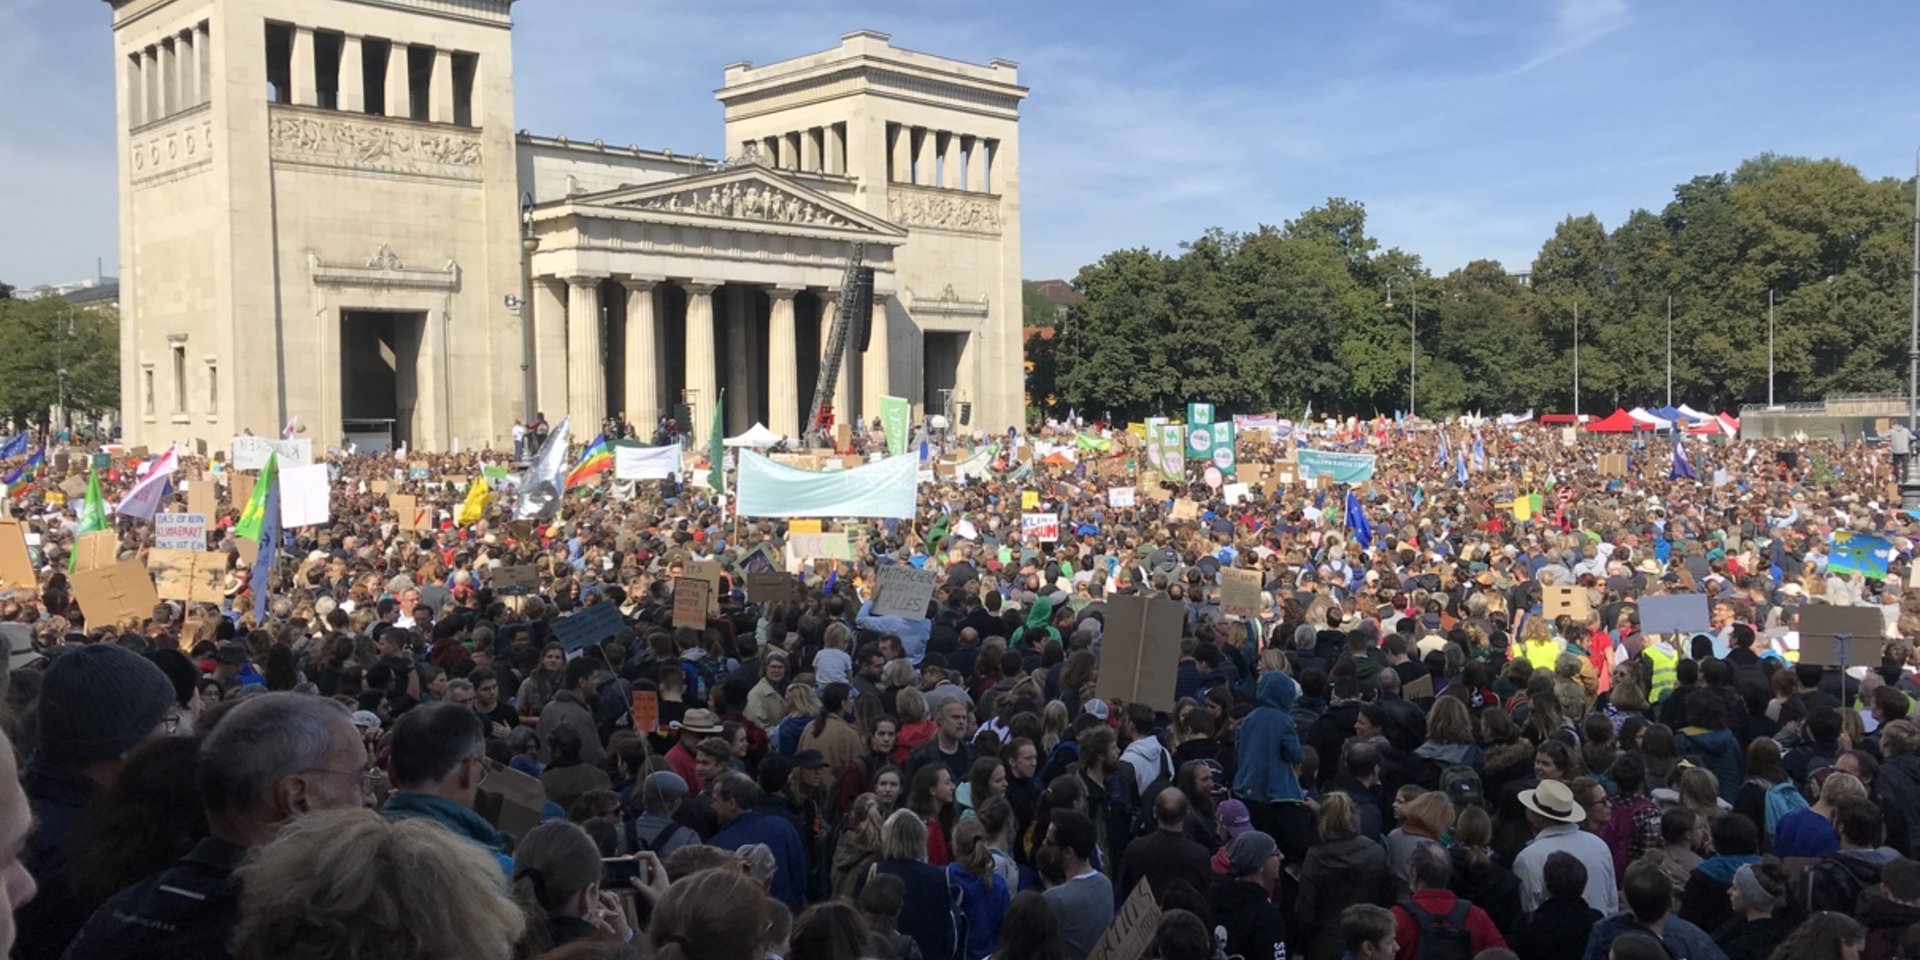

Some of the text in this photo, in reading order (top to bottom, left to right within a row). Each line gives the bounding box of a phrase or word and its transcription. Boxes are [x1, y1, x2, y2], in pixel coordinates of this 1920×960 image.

[157, 515, 173, 524] DAS
[176, 515, 187, 523] IST
[157, 541, 204, 550] DAS IST EIN
[881, 597, 922, 612] ALLES
